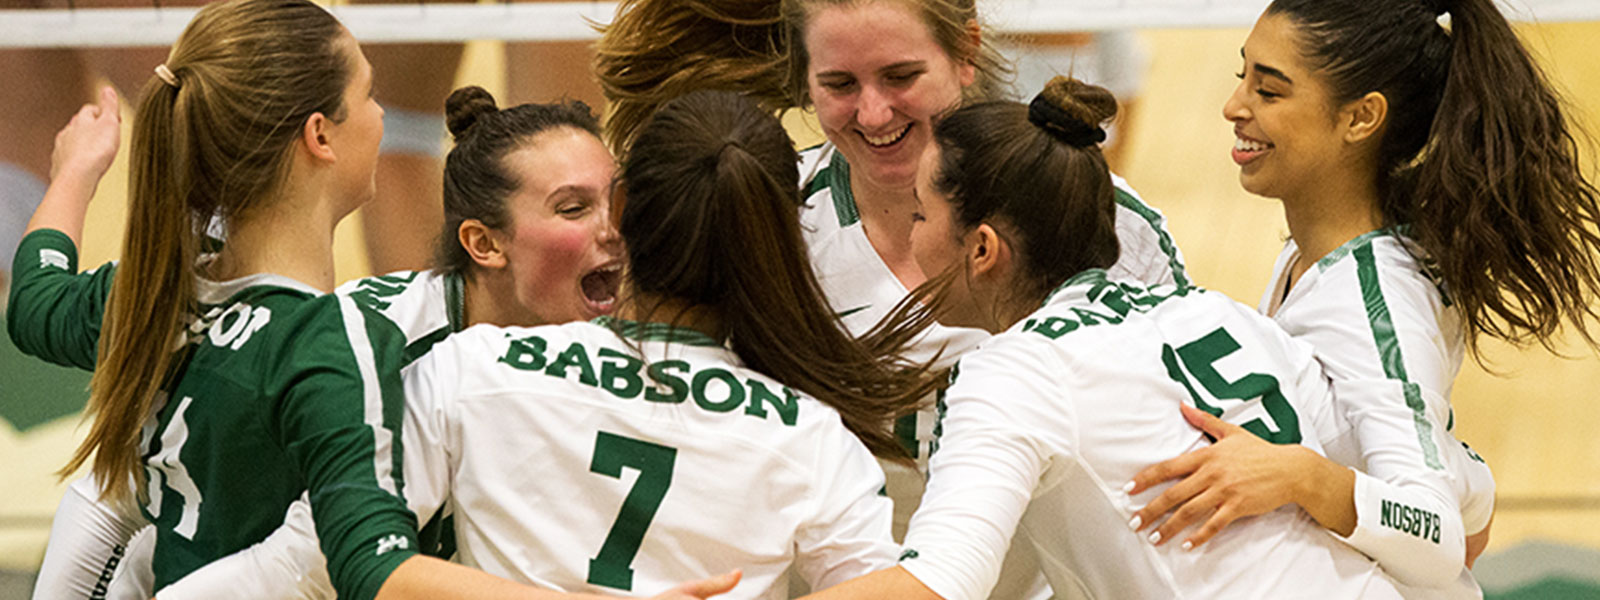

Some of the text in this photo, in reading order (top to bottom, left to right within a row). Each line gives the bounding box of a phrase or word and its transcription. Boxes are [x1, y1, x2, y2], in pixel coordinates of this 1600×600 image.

[497, 332, 799, 427] BABSON
[1161, 326, 1303, 445] 15
[586, 430, 678, 592] 7
[1380, 499, 1441, 544] BABSON
